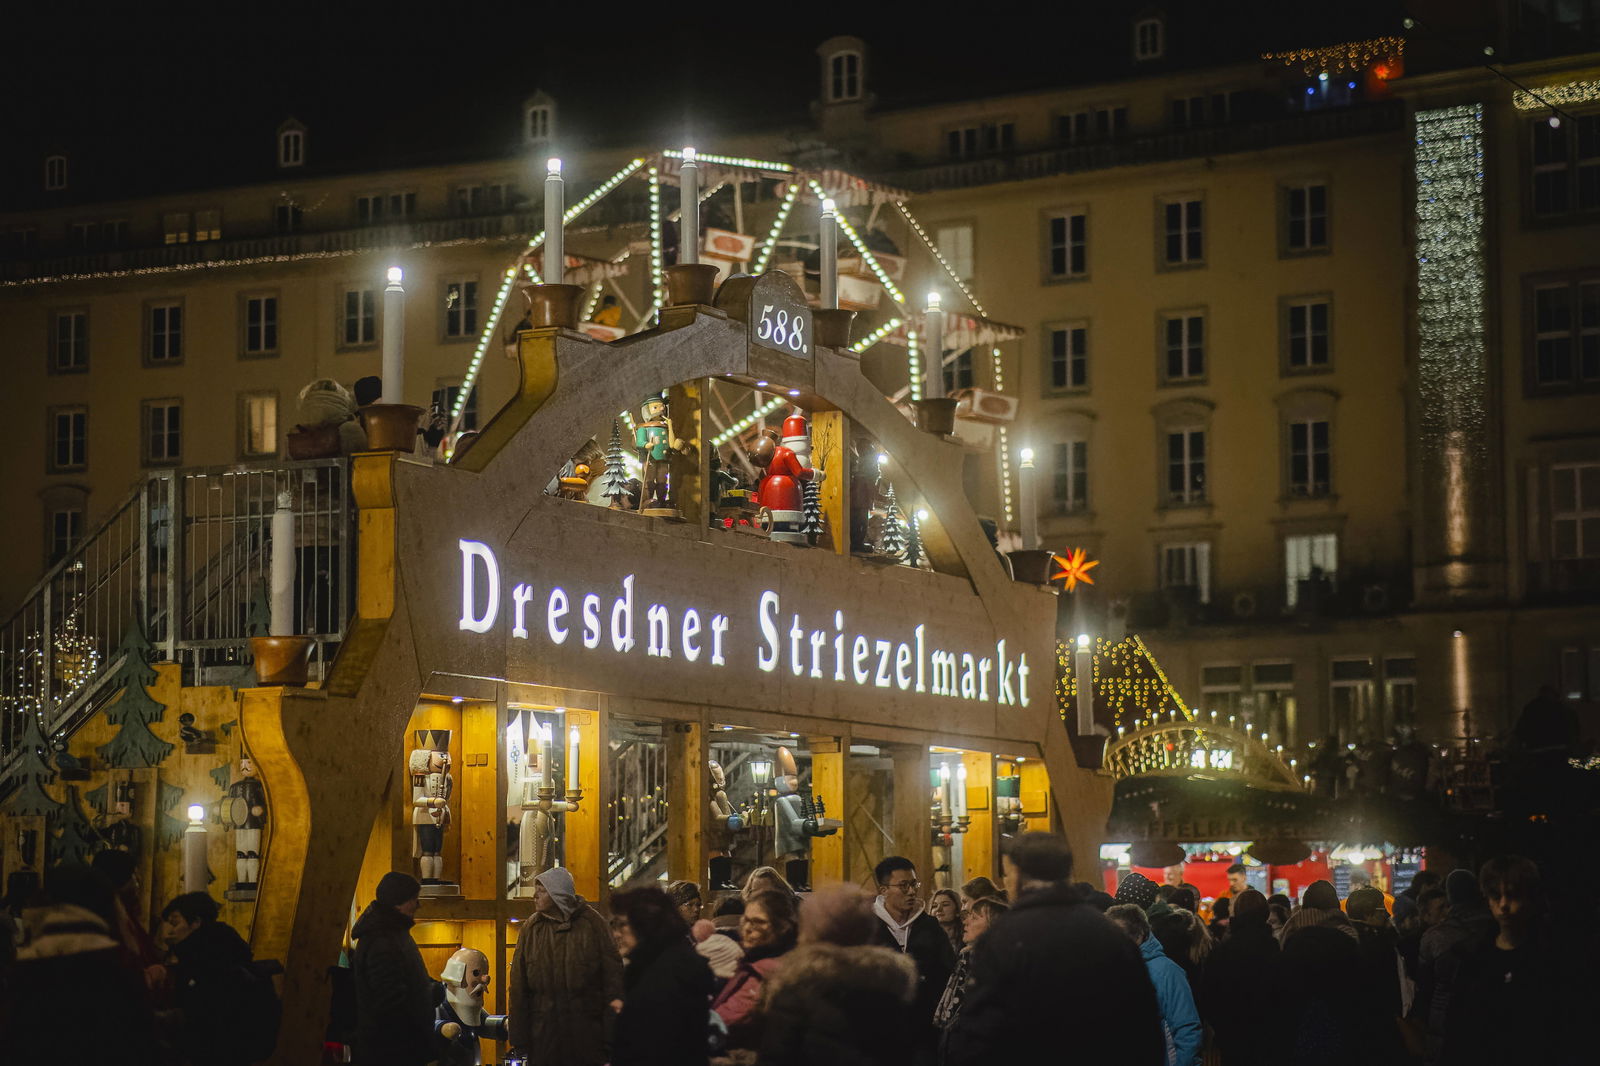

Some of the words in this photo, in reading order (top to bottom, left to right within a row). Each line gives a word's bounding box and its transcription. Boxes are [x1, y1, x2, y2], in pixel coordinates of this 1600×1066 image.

[757, 304, 808, 354] 588.
[459, 538, 729, 666] Dresdner
[758, 590, 1031, 708] Striezelmarkt
